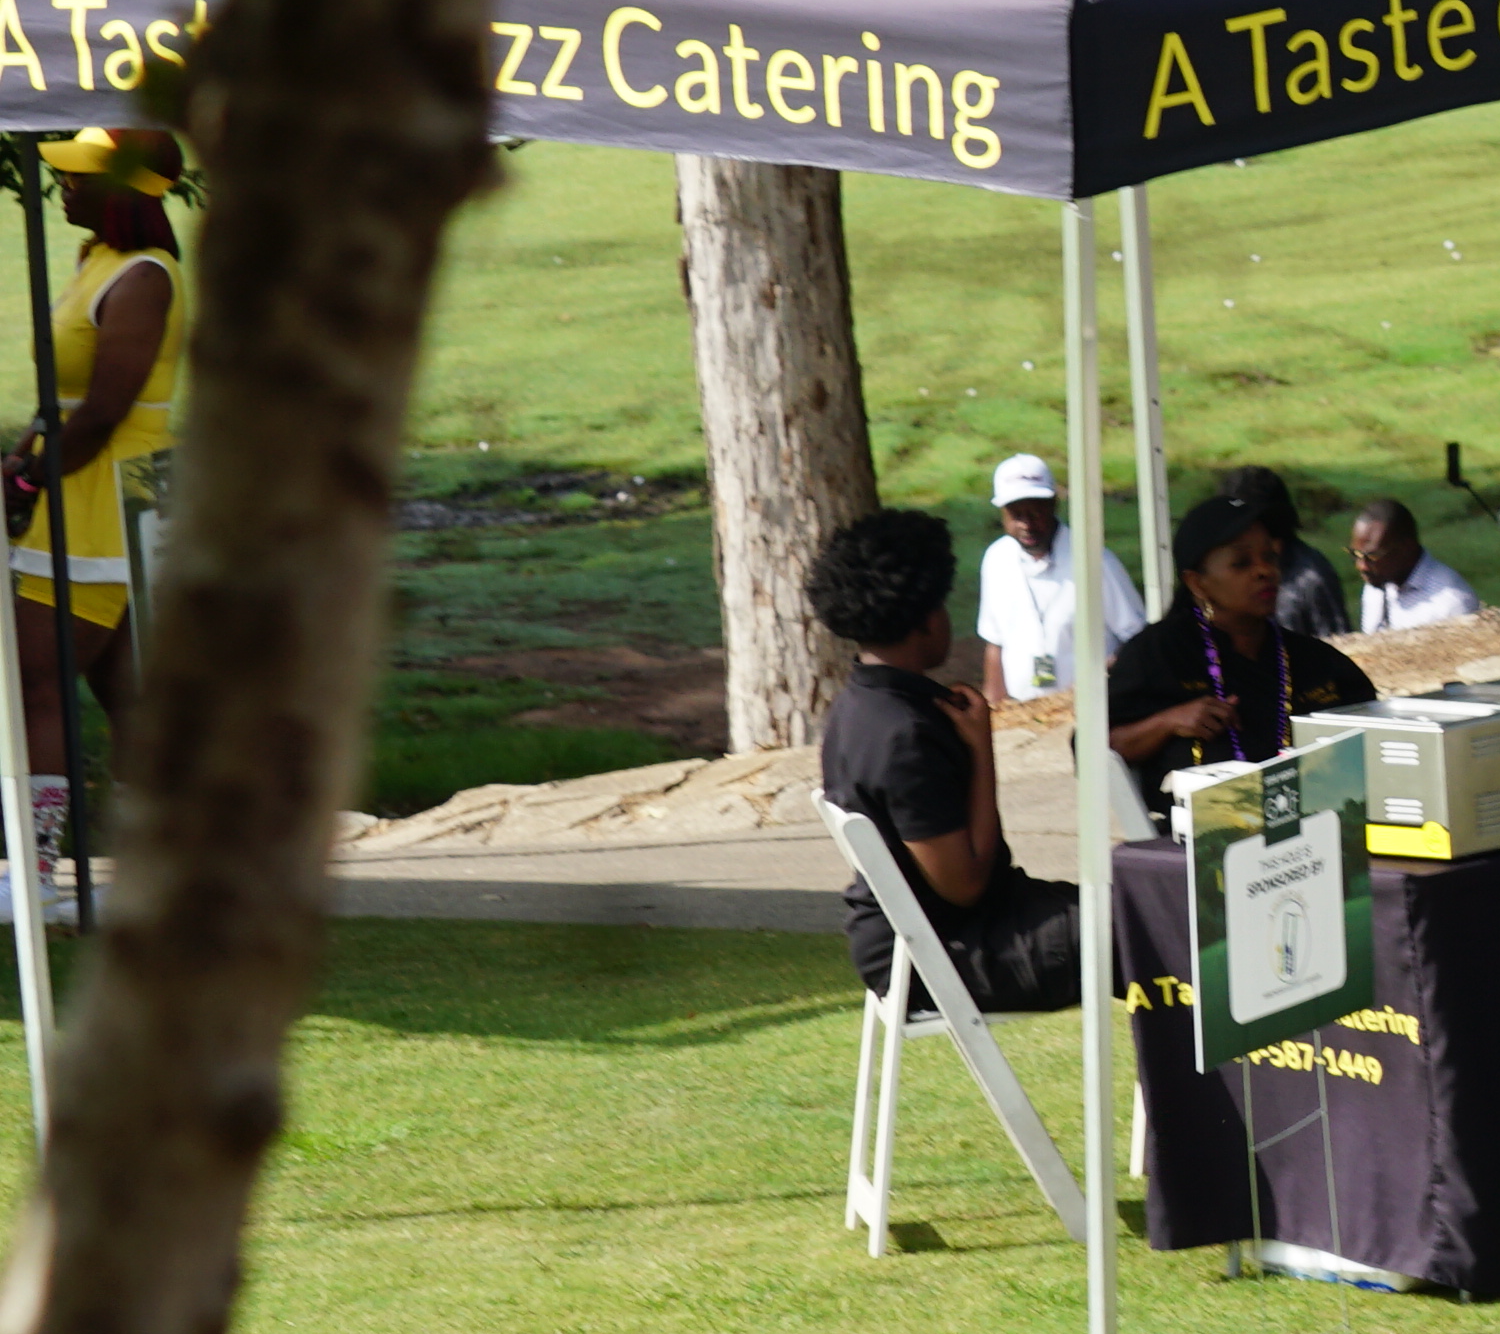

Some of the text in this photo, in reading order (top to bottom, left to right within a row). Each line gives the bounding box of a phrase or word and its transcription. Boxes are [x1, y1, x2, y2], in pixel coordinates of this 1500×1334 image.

[602, 6, 1002, 169] Catering
[1143, 30, 1216, 141] A
[1126, 980, 1153, 1015] A
